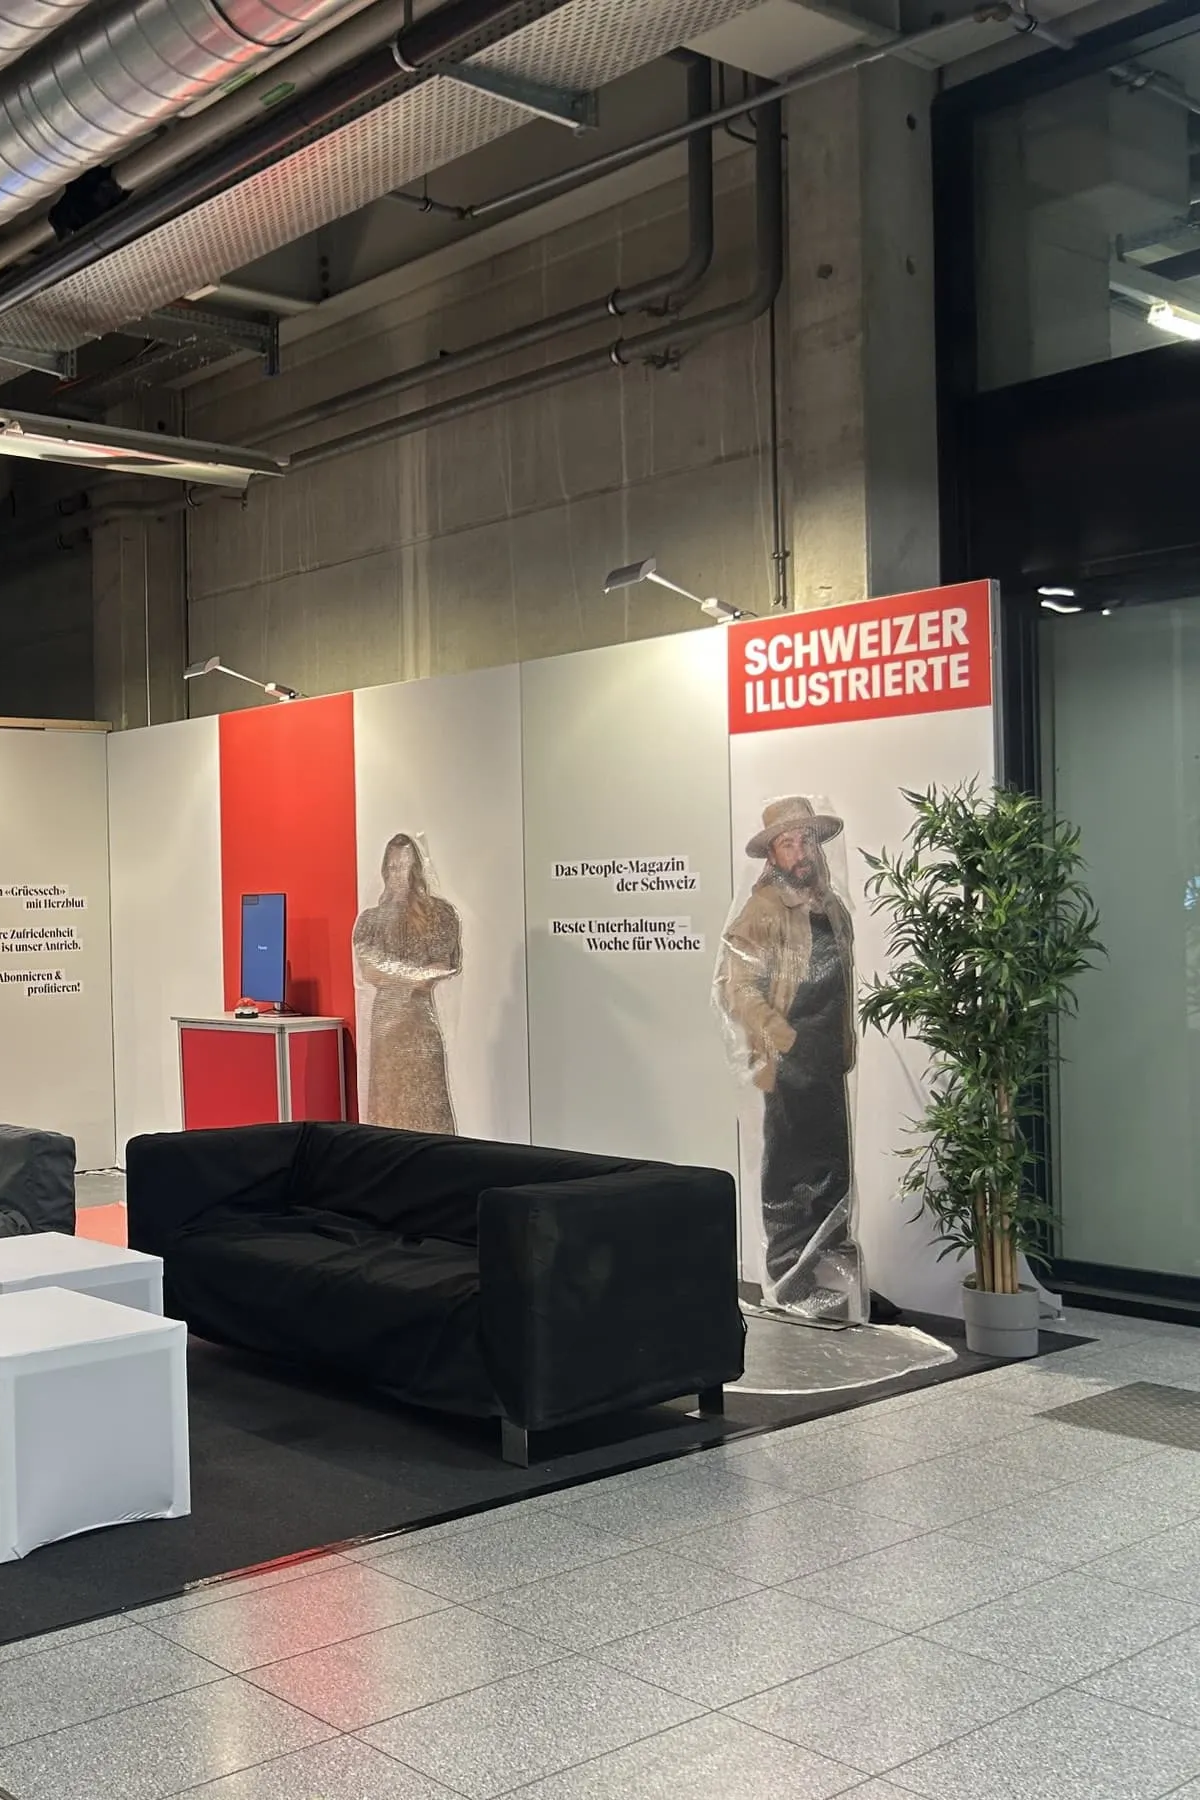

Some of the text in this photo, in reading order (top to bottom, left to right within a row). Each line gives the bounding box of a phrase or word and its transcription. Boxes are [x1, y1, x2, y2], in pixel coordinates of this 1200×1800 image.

[744, 608, 970, 675] SCHWEIZER
[744, 652, 970, 714] ILLUSTRIERTE
[555, 857, 685, 878] Das People-Magazin
[5, 885, 66, 896] «Grüessech»
[616, 875, 696, 892] der Schweiz
[26, 898, 84, 909] mit Herzblut
[10, 928, 73, 940] Zufriedenheit
[553, 920, 586, 934] Beste
[588, 919, 676, 935] Unterhaltung
[1, 940, 81, 952] ist unser Antrieb.
[587, 936, 700, 951] Woche für Woche
[54, 970, 62, 980] &
[27, 982, 81, 997] profitieren!
